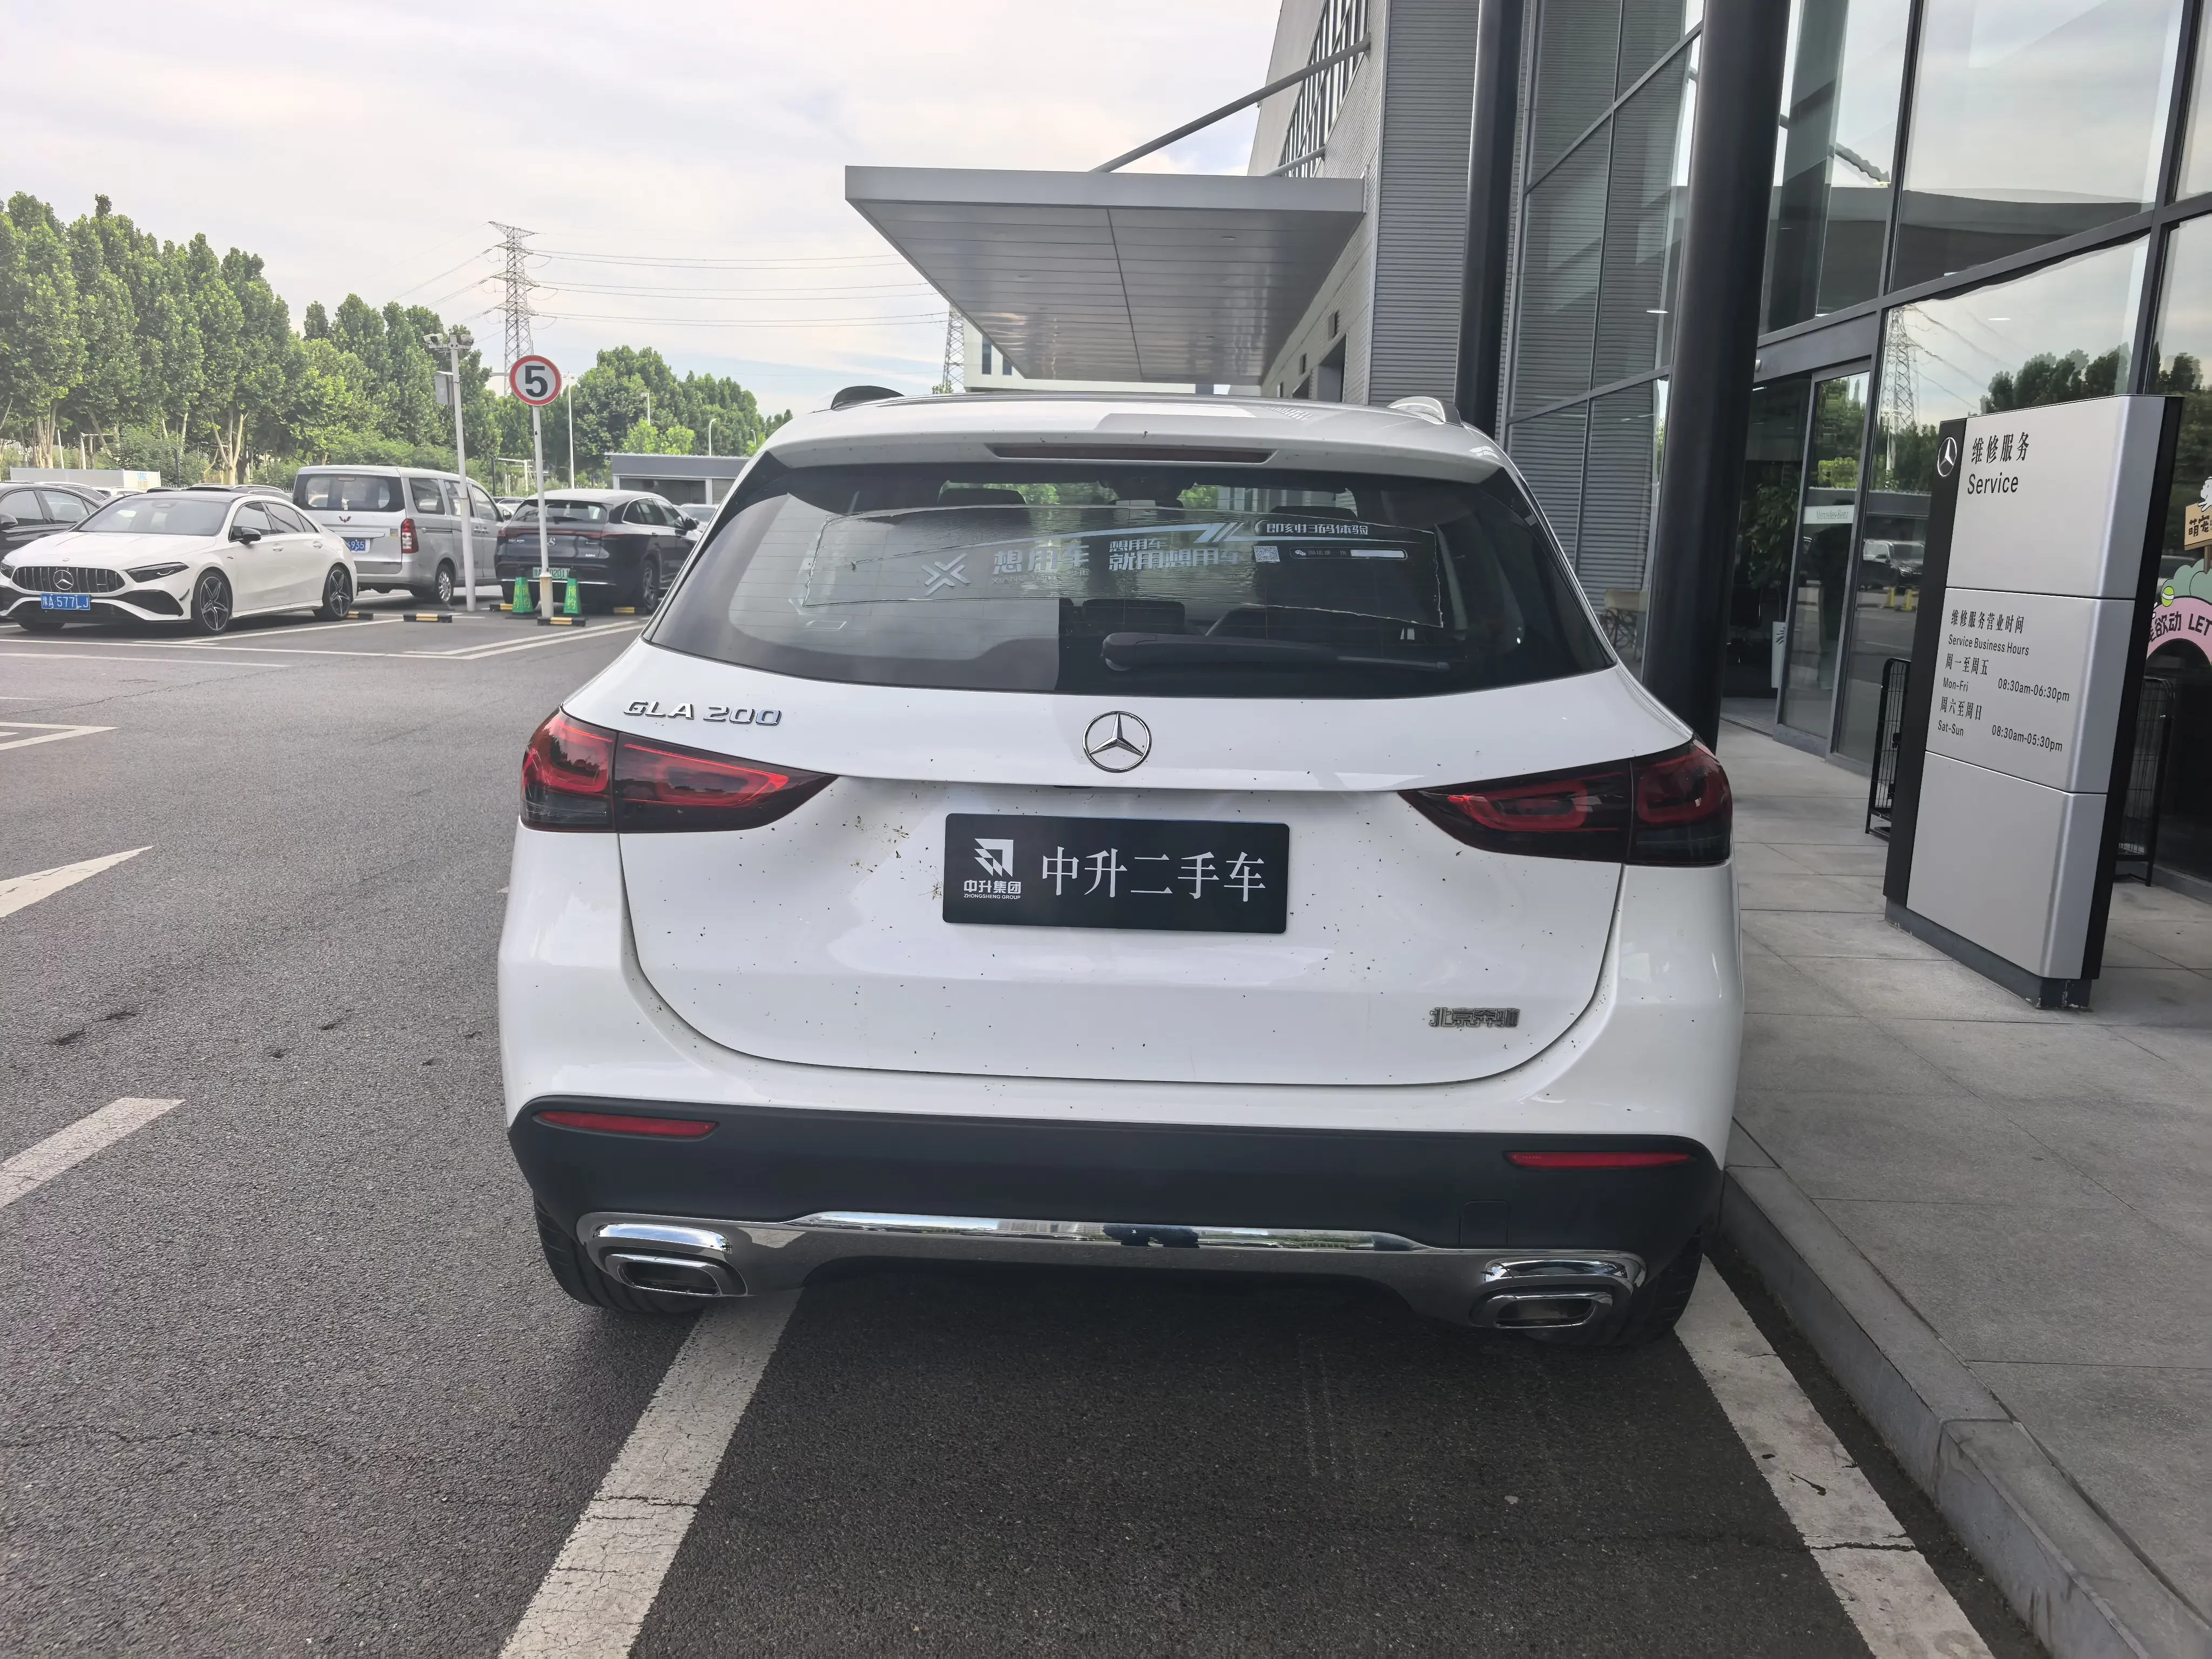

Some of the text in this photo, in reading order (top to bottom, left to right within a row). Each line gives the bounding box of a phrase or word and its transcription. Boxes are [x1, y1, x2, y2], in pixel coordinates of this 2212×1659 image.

[525, 365, 548, 397] 5
[1971, 431, 2029, 465] 维修服务
[1967, 471, 2019, 495] Service
[2188, 515, 2212, 537] 萌宠
[1951, 609, 2025, 634] 维修服务营业时间
[1948, 634, 2029, 656] Service Business Hours
[1945, 653, 1989, 676] 周一至周五
[1943, 677, 2069, 703] Mon-Fri 08:30am-06:30pm
[623, 699, 782, 726] GLA 200
[1940, 696, 1982, 721] 周六至周日
[1938, 720, 2063, 752] Sat-Sun 08:30am-05:30pm
[963, 879, 1021, 894] 中升集团
[1041, 846, 1266, 902] 中升二手车
